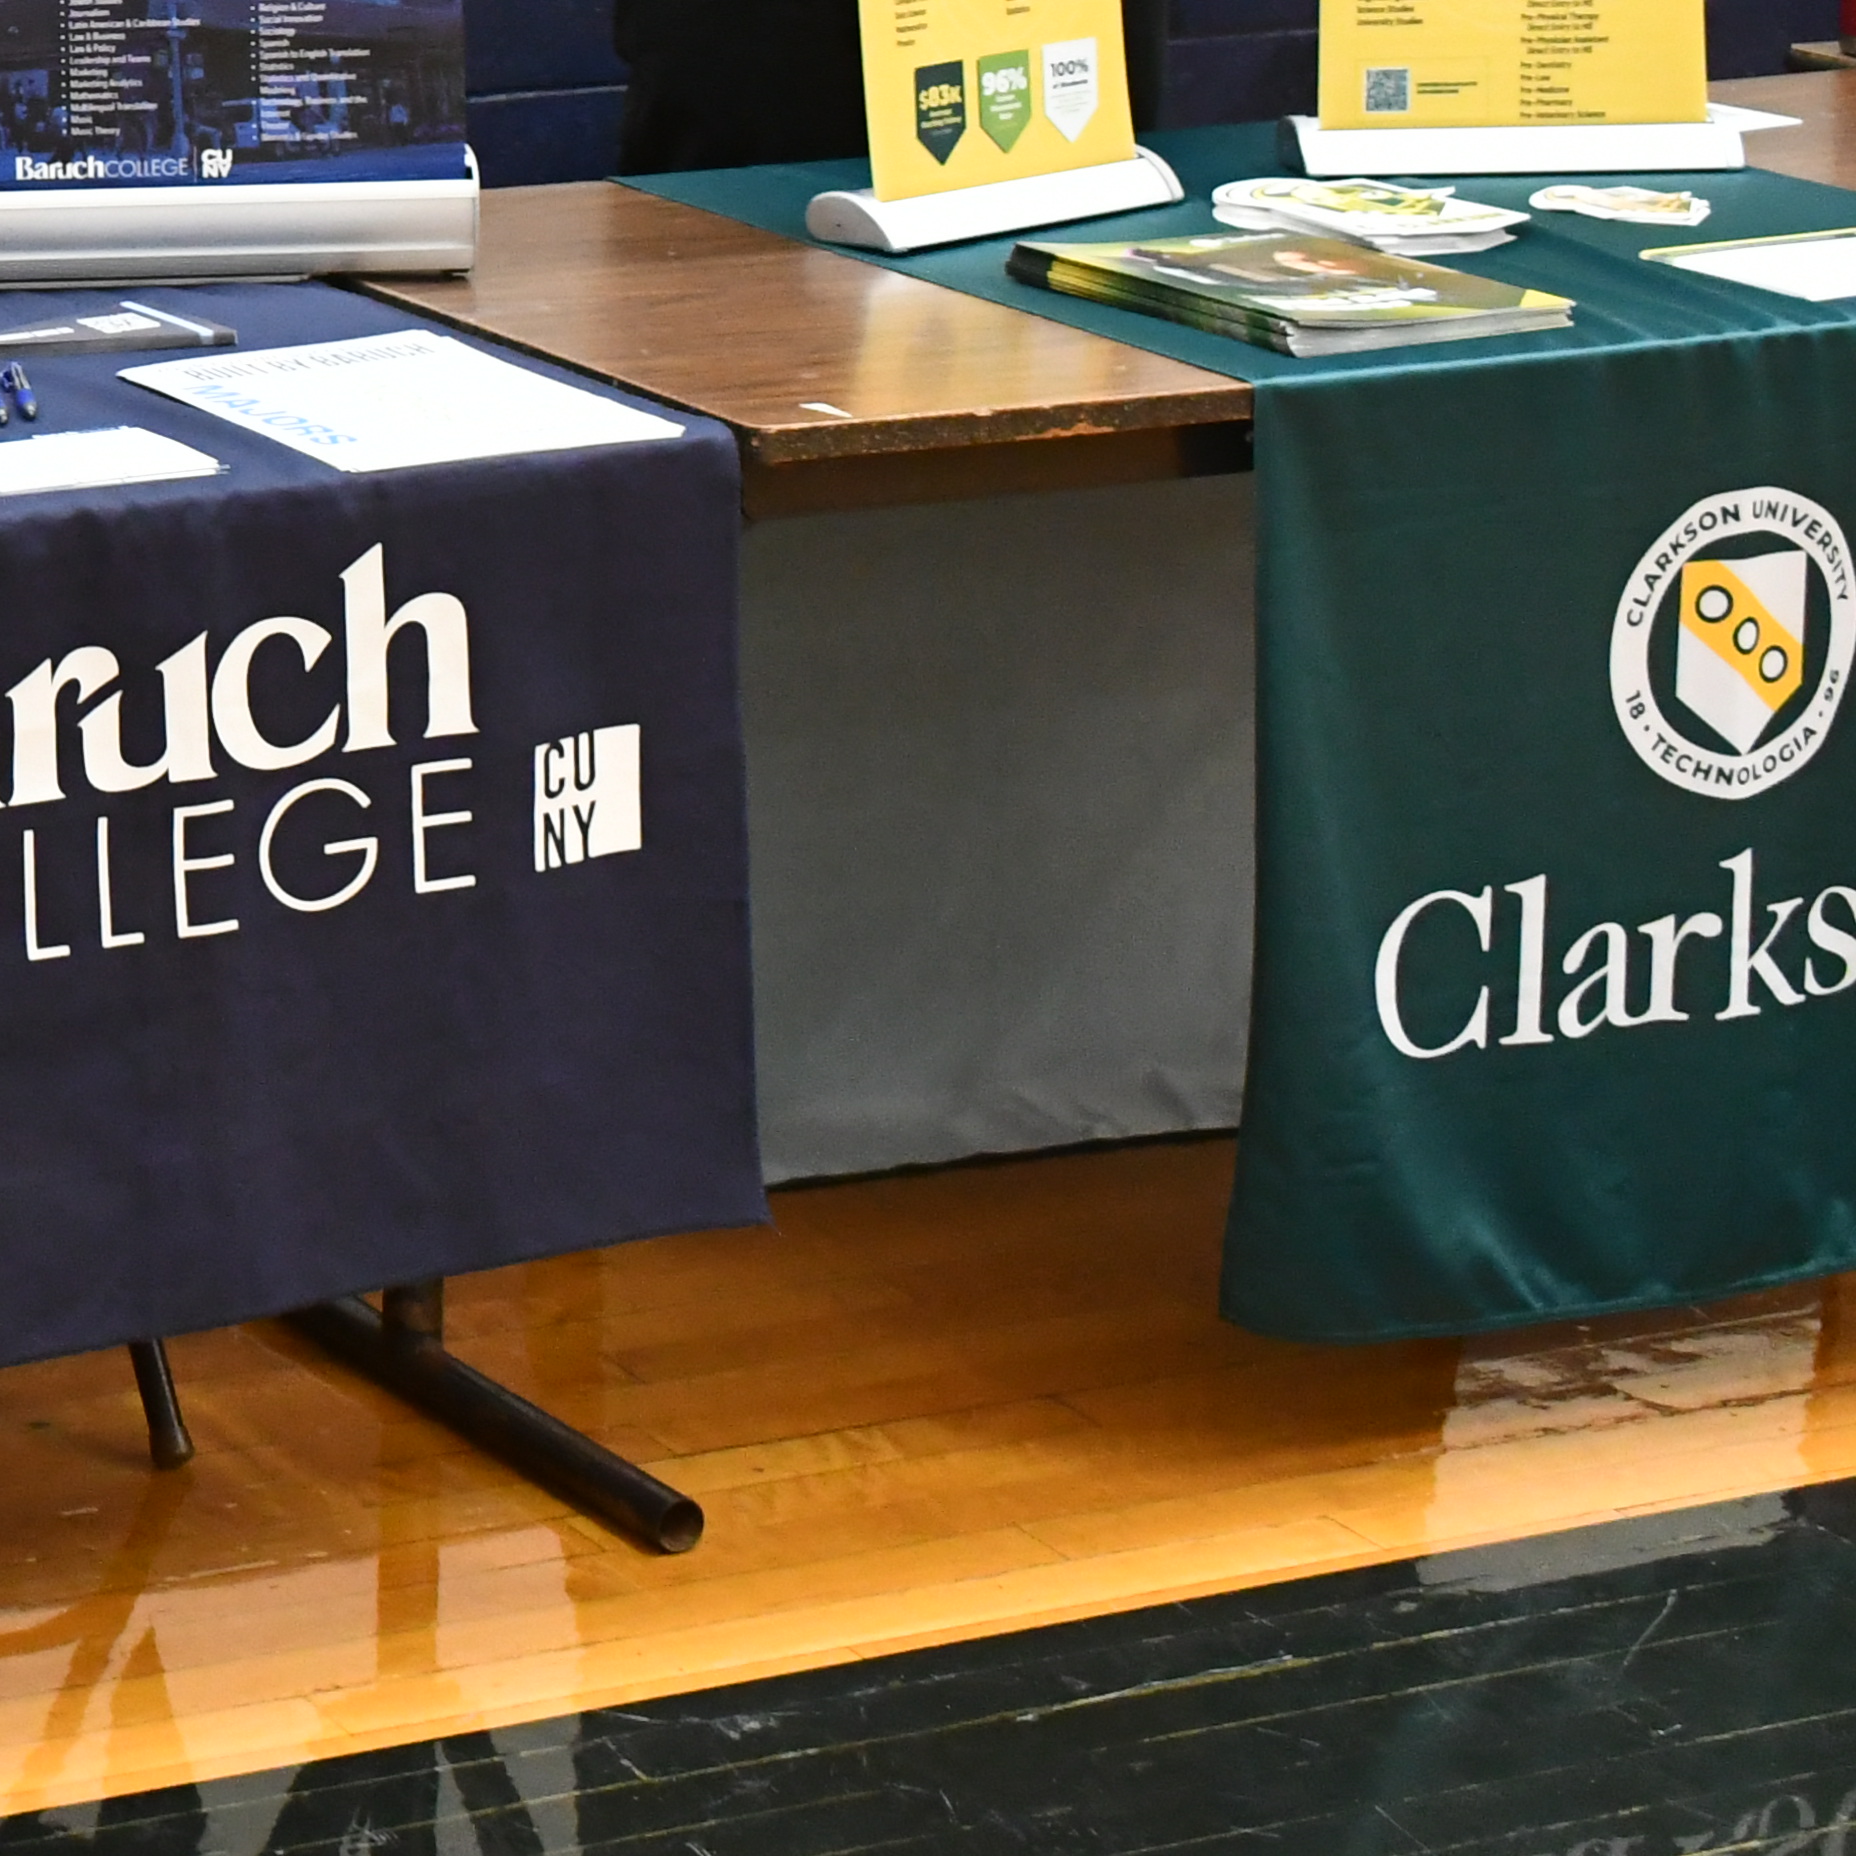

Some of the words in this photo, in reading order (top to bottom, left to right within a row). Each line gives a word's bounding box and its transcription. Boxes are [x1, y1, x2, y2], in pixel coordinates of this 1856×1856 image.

[981, 66, 1027, 96] 96%
[1050, 59, 1089, 77] 100%
[185, 383, 357, 447] MAJORS
[1626, 502, 1742, 628] CLARKSON
[1751, 499, 1850, 602] UNIVERSITY
[1626, 690, 1646, 721] 18
[1650, 724, 1819, 786] TECHNOLOGIA
[1822, 668, 1840, 701] 96
[1374, 847, 1856, 1059] Clarks
